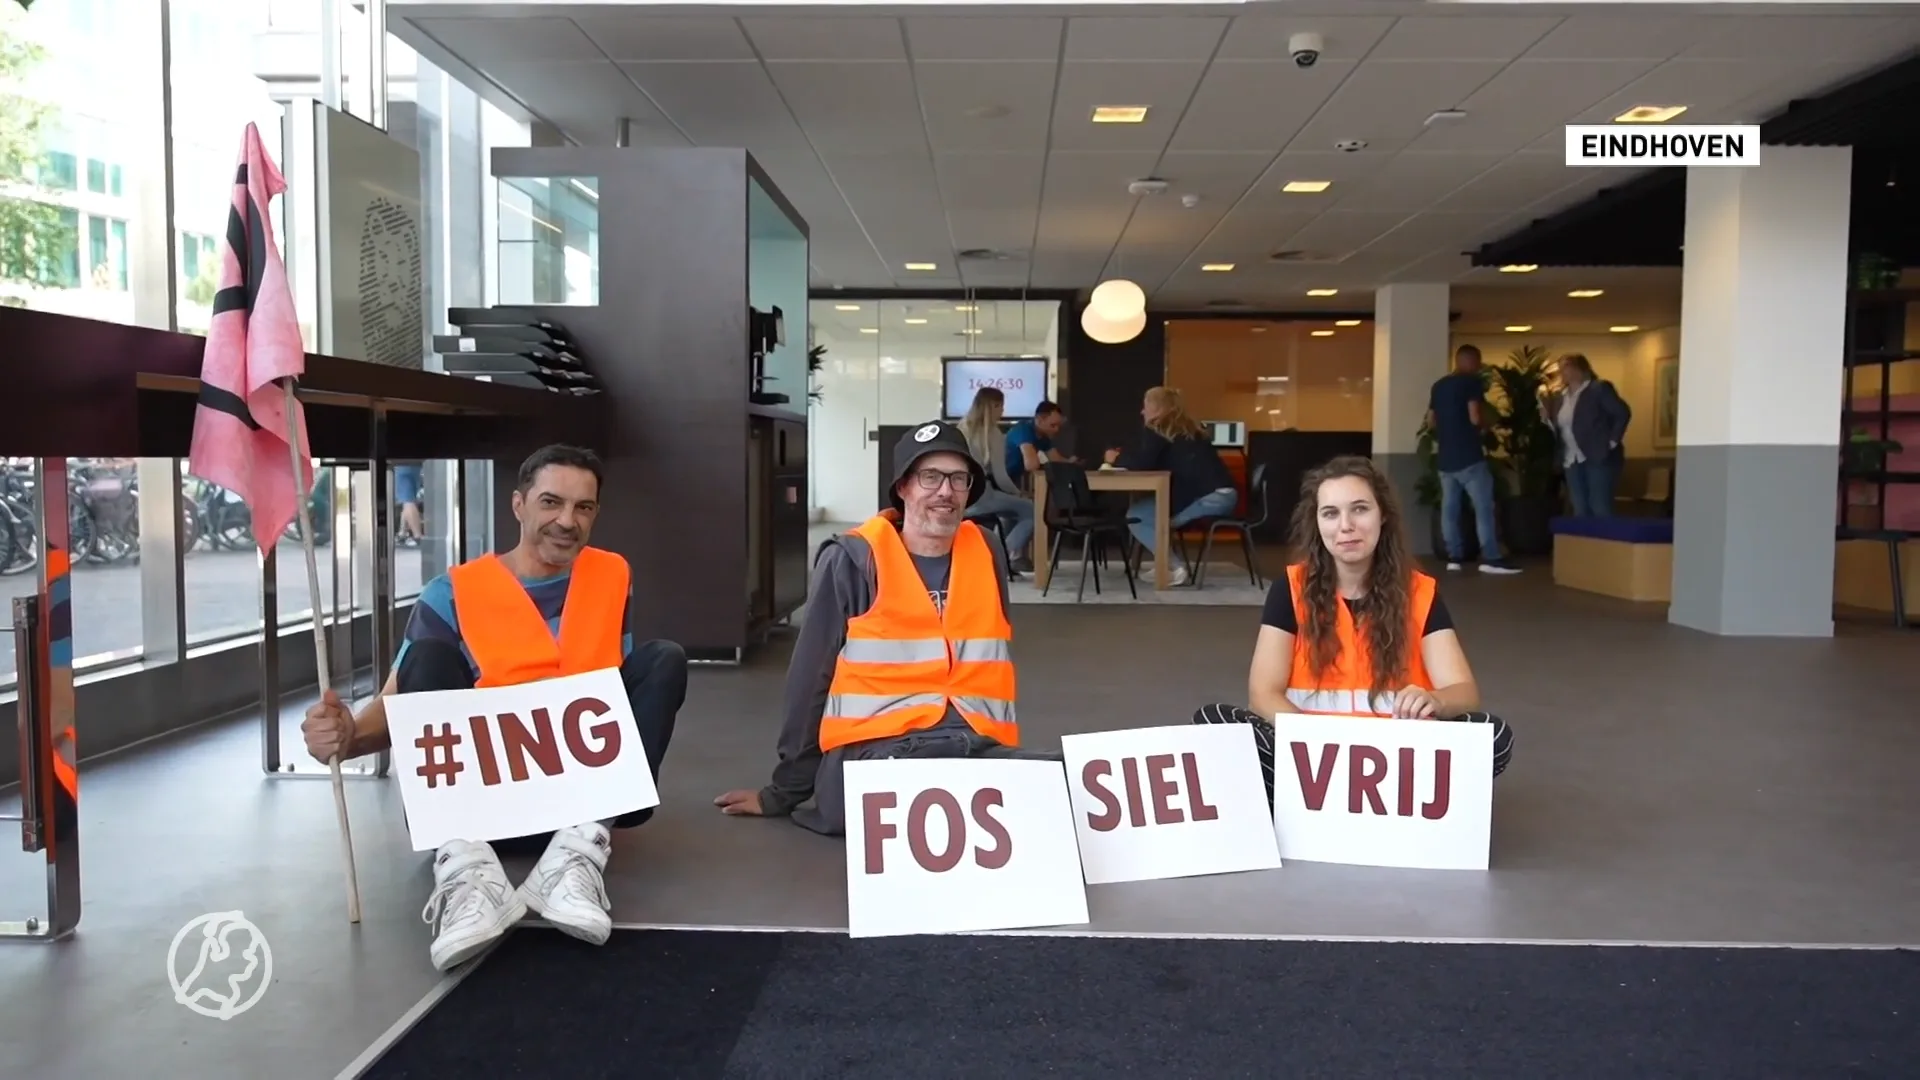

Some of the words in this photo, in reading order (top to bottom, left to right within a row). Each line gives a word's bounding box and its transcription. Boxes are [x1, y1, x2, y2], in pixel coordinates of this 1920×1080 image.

[414, 697, 621, 789] #ING
[1289, 741, 1452, 820] VRIJ
[862, 787, 1013, 875] FOS
[1082, 752, 1219, 832] SIEL
